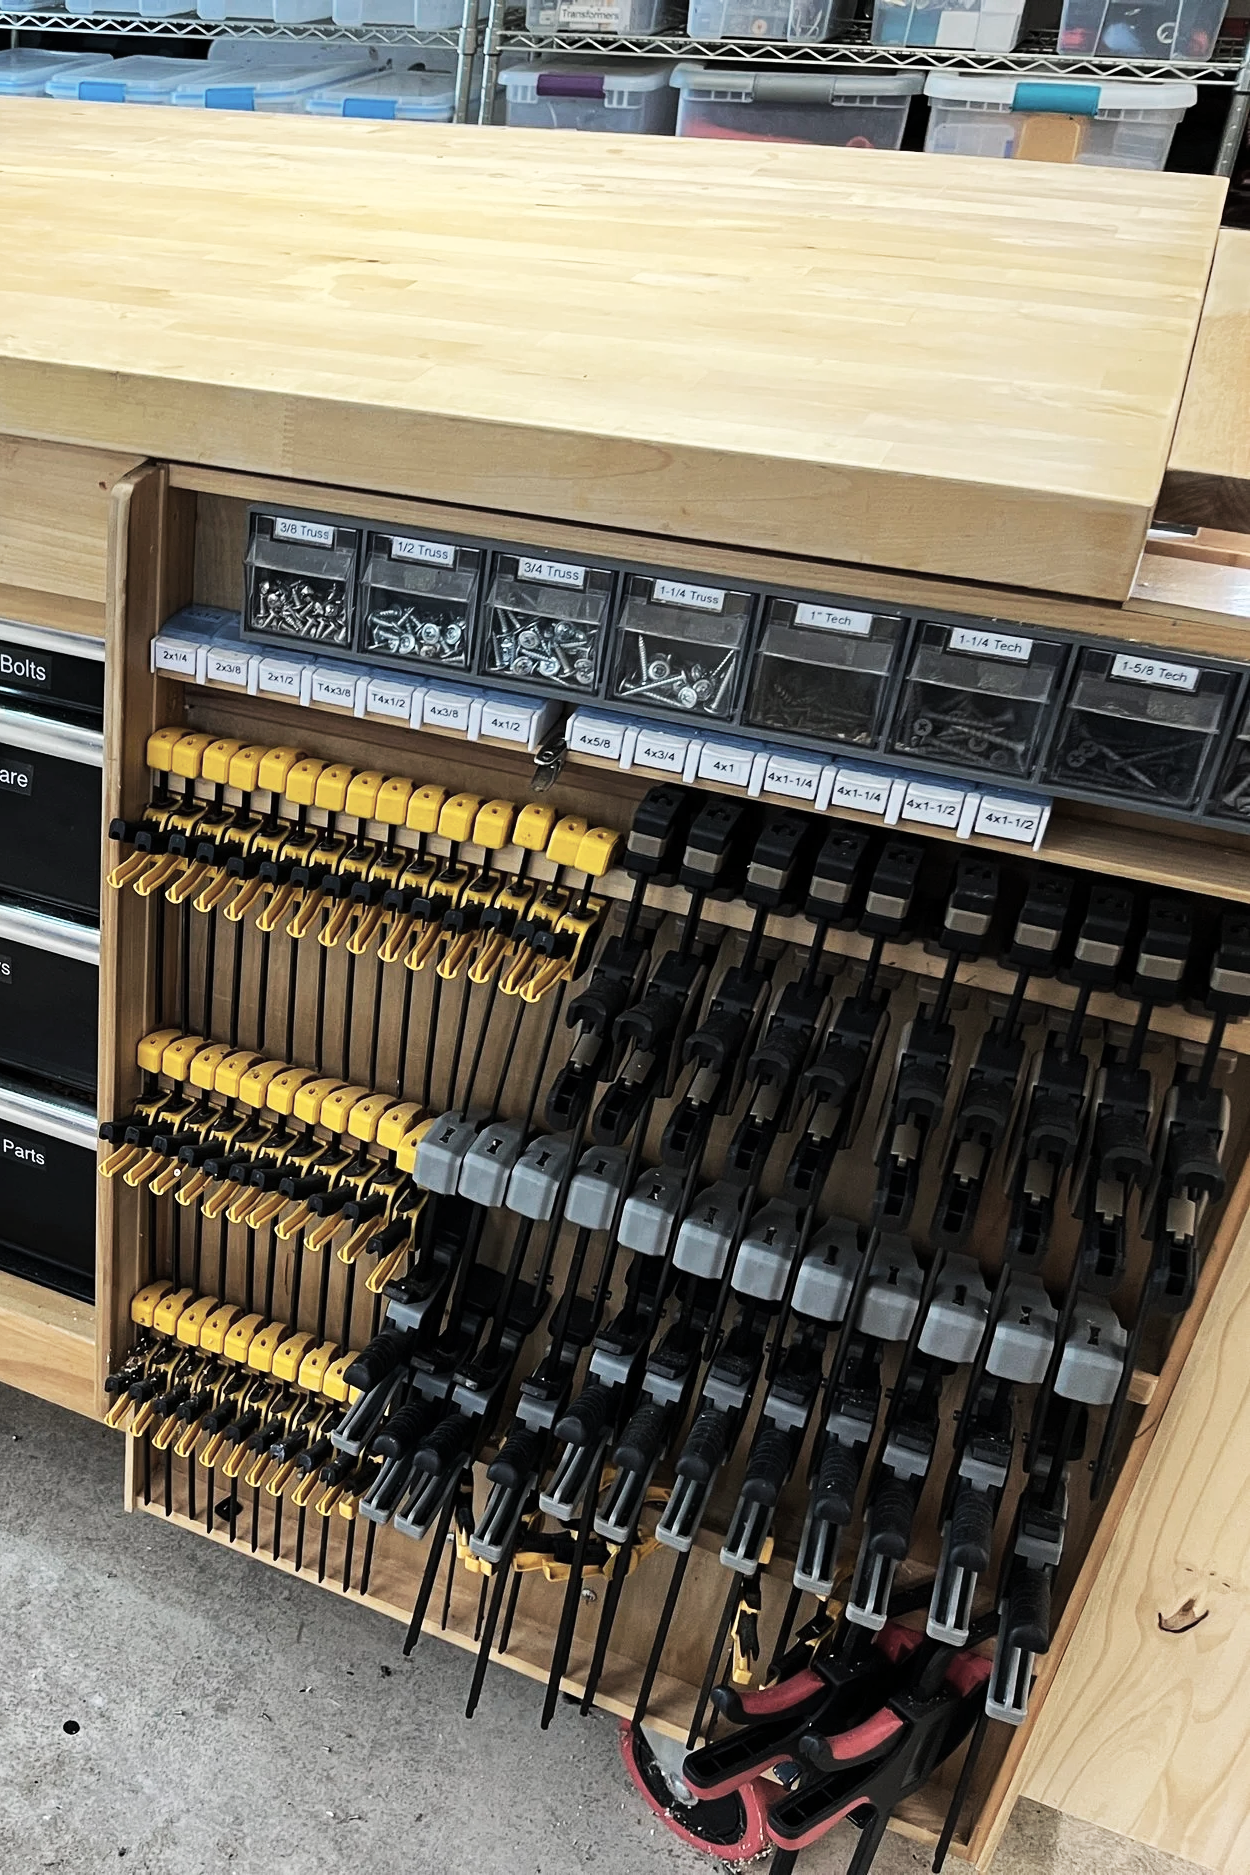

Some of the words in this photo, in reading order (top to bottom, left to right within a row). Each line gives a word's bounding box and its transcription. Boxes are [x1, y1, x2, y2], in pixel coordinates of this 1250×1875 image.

[562, 8, 619, 20] Transformers
[280, 522, 298, 534] 3/8
[302, 526, 329, 540] Truss
[398, 542, 414, 554] 1/2
[418, 545, 448, 559] Truss
[524, 562, 543, 574] 3/4
[546, 566, 579, 581] Truss
[660, 586, 686, 598] 1-1/4
[690, 591, 719, 605] Truss
[810, 611, 822, 621] 1"
[825, 613, 852, 626] Tech
[959, 634, 989, 648] 1-1/4
[994, 639, 1022, 654] Tech
[163, 650, 188, 663] 2x1/4
[0, 654, 46, 681] Bolts
[216, 663, 241, 675] 2x3/8
[1122, 661, 1154, 676] 1-5/8
[1158, 668, 1188, 683] Tech
[268, 673, 294, 685] 2x1/2
[430, 706, 459, 718] 4x3/8
[490, 718, 520, 732] 4x1/2
[580, 735, 611, 749] 4x5/8
[644, 748, 675, 762] 4x3/4
[713, 760, 734, 773] 4x1
[768, 773, 812, 789] 4x1-1/4
[837, 786, 881, 802] 4x1-1/4
[906, 798, 956, 816] 4x1-1/2
[985, 813, 1034, 830] 4x1-1/2
[3, 1139, 45, 1165] Parts
